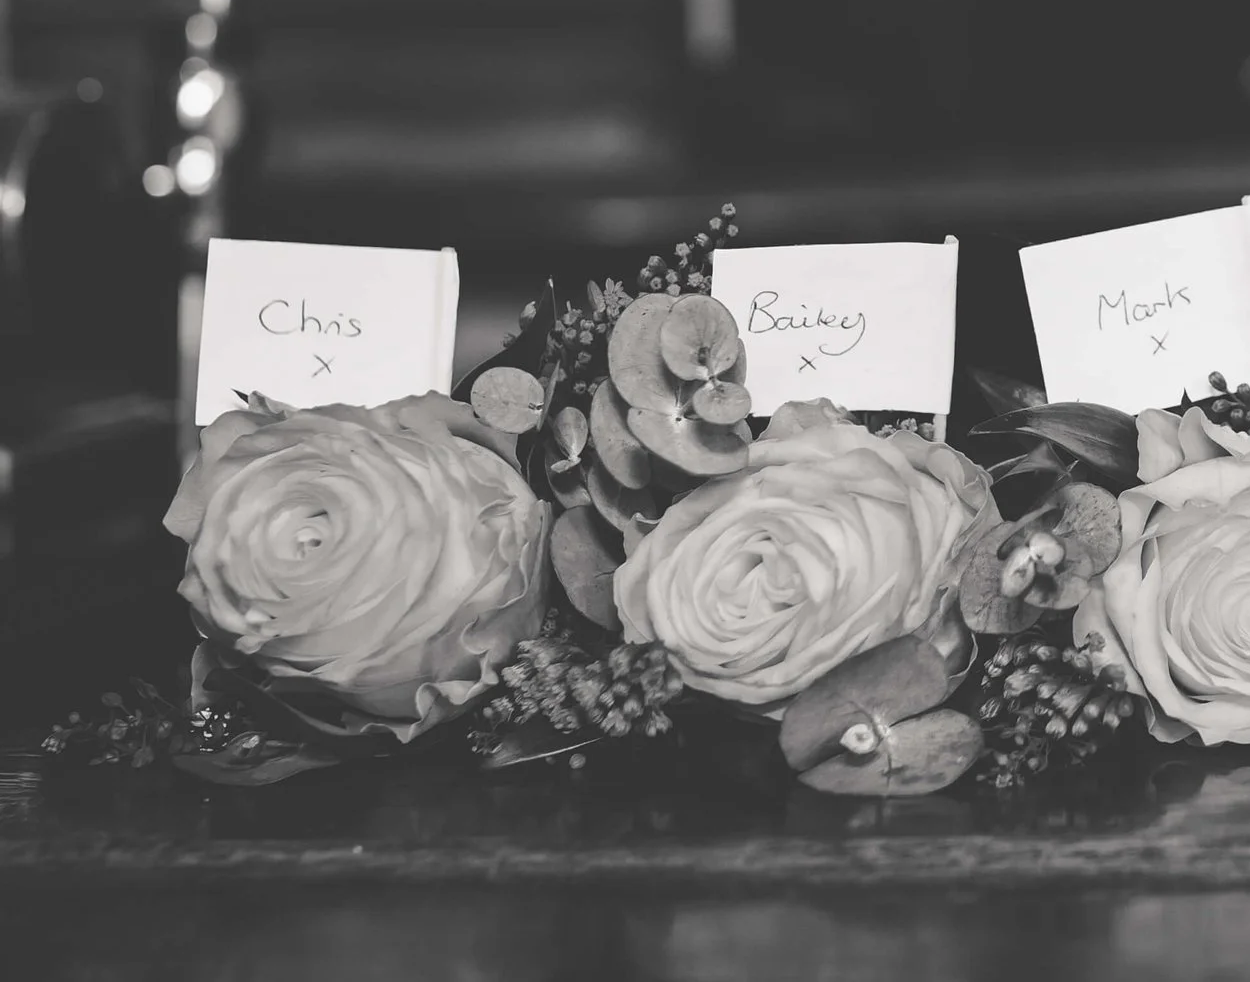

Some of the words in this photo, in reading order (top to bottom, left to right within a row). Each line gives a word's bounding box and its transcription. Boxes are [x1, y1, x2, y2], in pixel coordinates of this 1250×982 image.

[259, 299, 362, 337] Chris
[748, 290, 866, 356] Bailey
[1098, 281, 1191, 331] Mark
